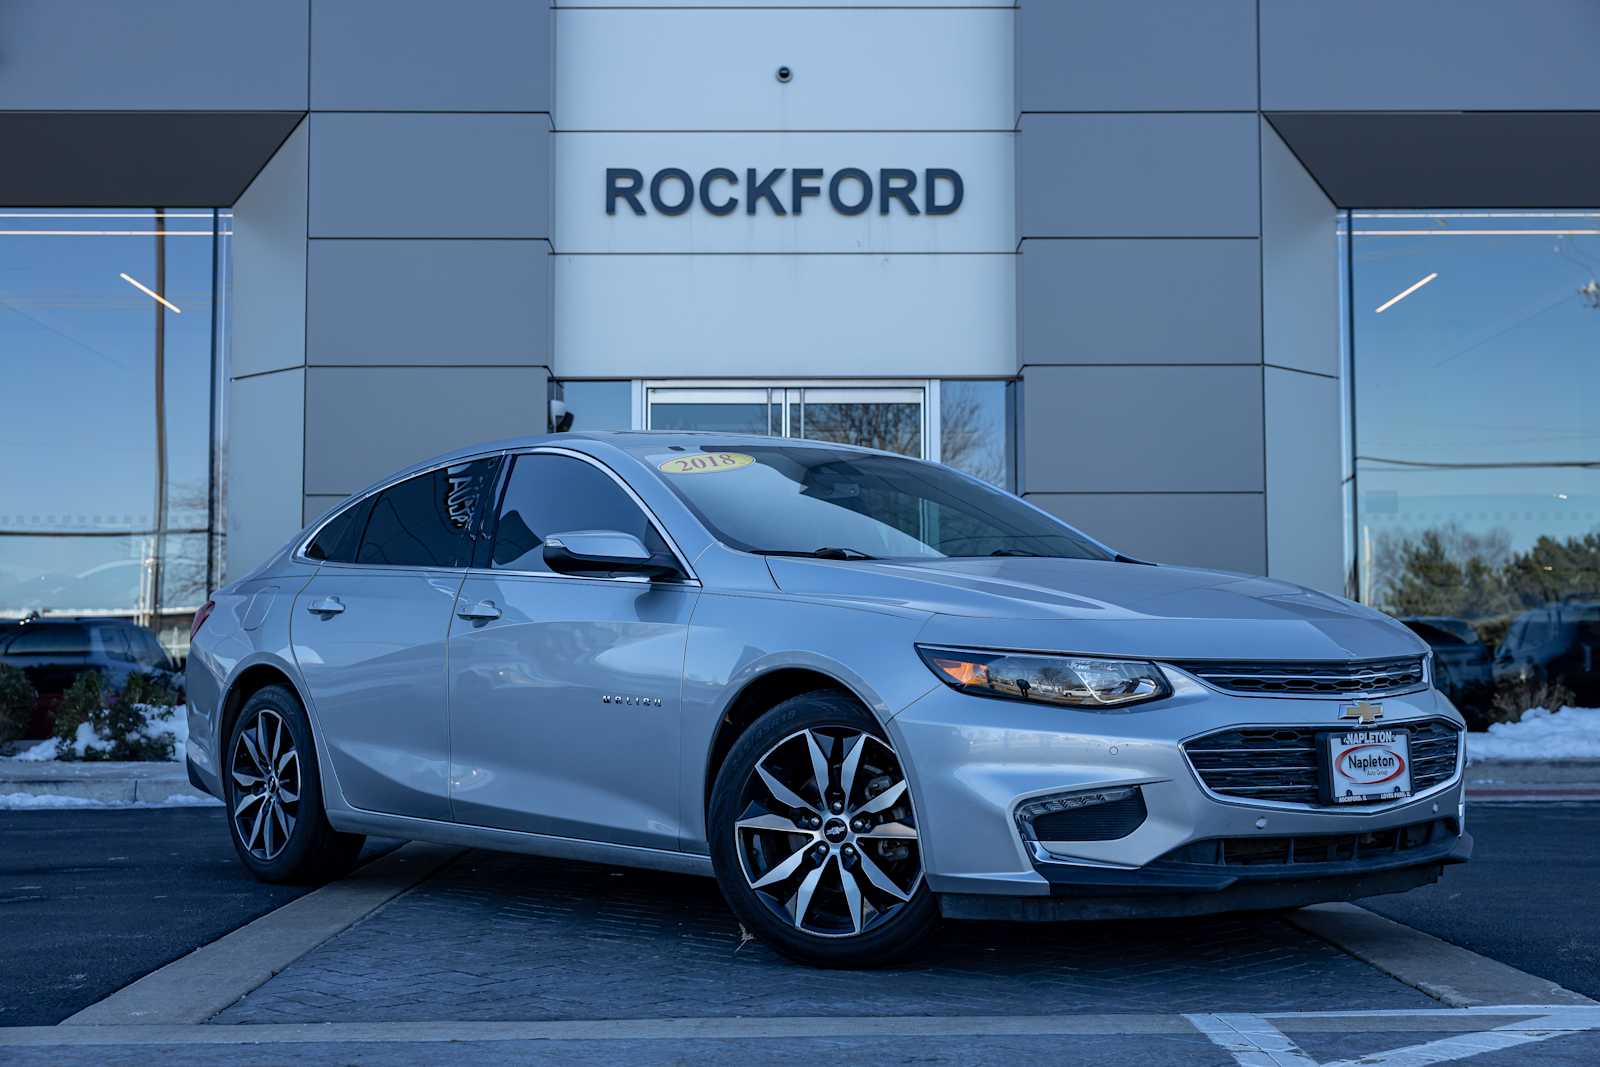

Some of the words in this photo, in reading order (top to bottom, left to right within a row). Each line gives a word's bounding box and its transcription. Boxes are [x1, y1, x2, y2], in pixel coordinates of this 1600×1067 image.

[605, 167, 965, 217] ROCKFORD
[675, 454, 735, 471] 2018
[1346, 731, 1393, 744] NAPLETON
[1348, 754, 1394, 772] Napleton
